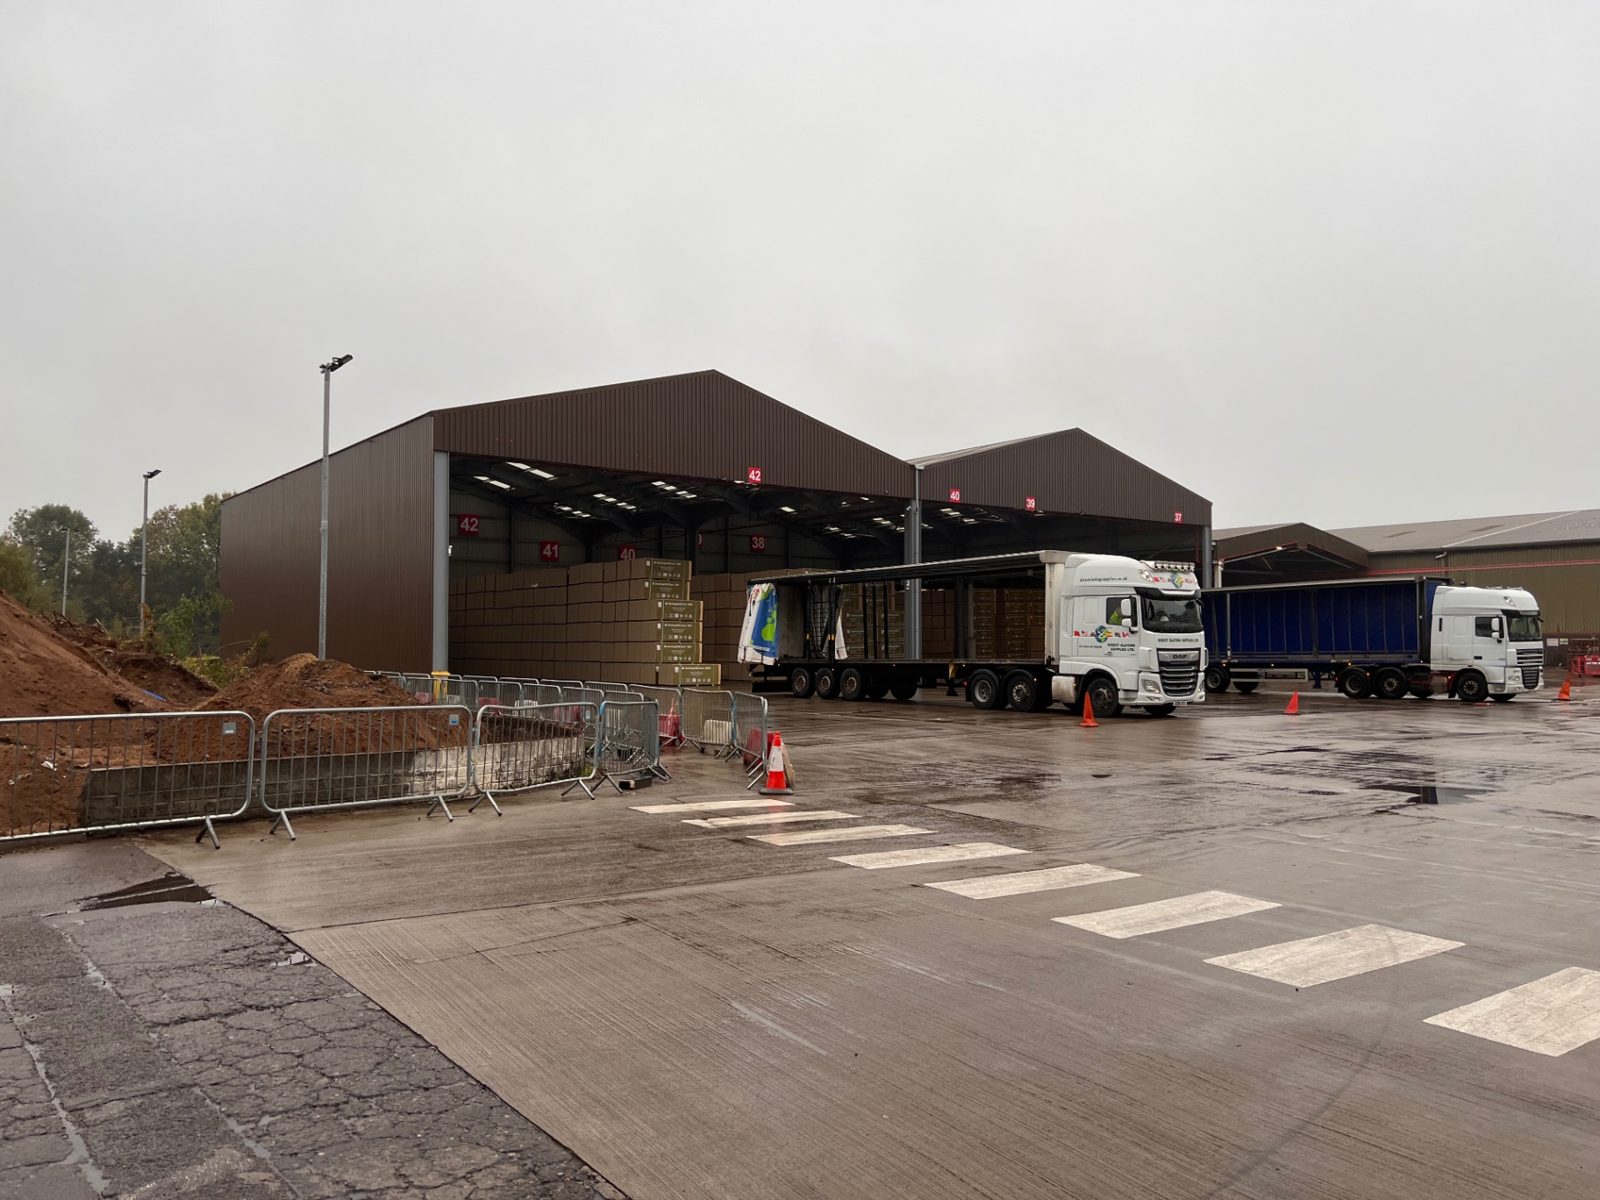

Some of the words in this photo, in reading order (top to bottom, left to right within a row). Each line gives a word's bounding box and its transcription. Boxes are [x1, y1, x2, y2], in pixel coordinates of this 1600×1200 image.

[749, 469, 761, 481] 42
[950, 491, 960, 501] 40
[1026, 498, 1035, 508] 39
[1174, 512, 1182, 522] 37
[460, 517, 479, 531] 42
[752, 536, 765, 549] 38
[543, 543, 558, 558] 41
[620, 548, 635, 560] 40
